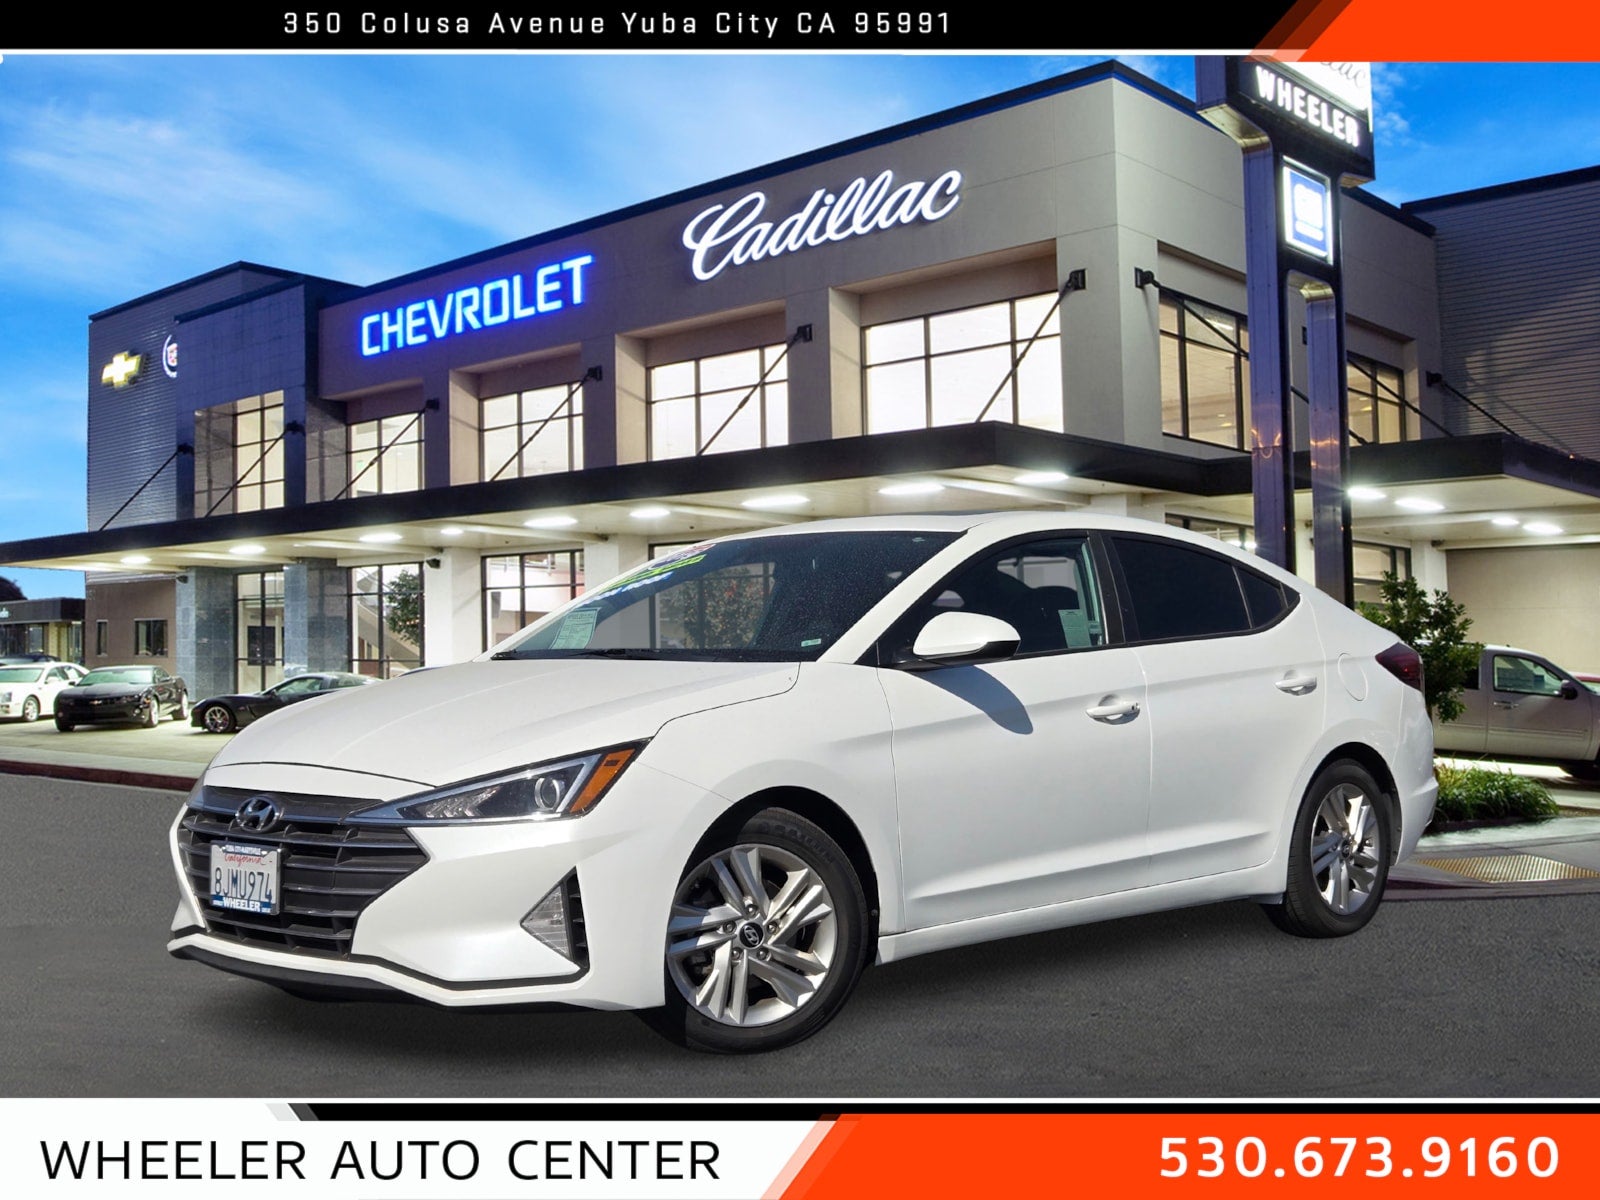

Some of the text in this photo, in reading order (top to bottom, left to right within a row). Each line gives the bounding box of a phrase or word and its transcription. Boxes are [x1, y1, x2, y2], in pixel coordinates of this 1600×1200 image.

[1255, 65, 1360, 147] WHEELER
[683, 169, 962, 281] Cadillac
[361, 255, 593, 356] CHEVROLET
[214, 867, 273, 902] 8JMU974
[223, 896, 261, 912] WHEELER
